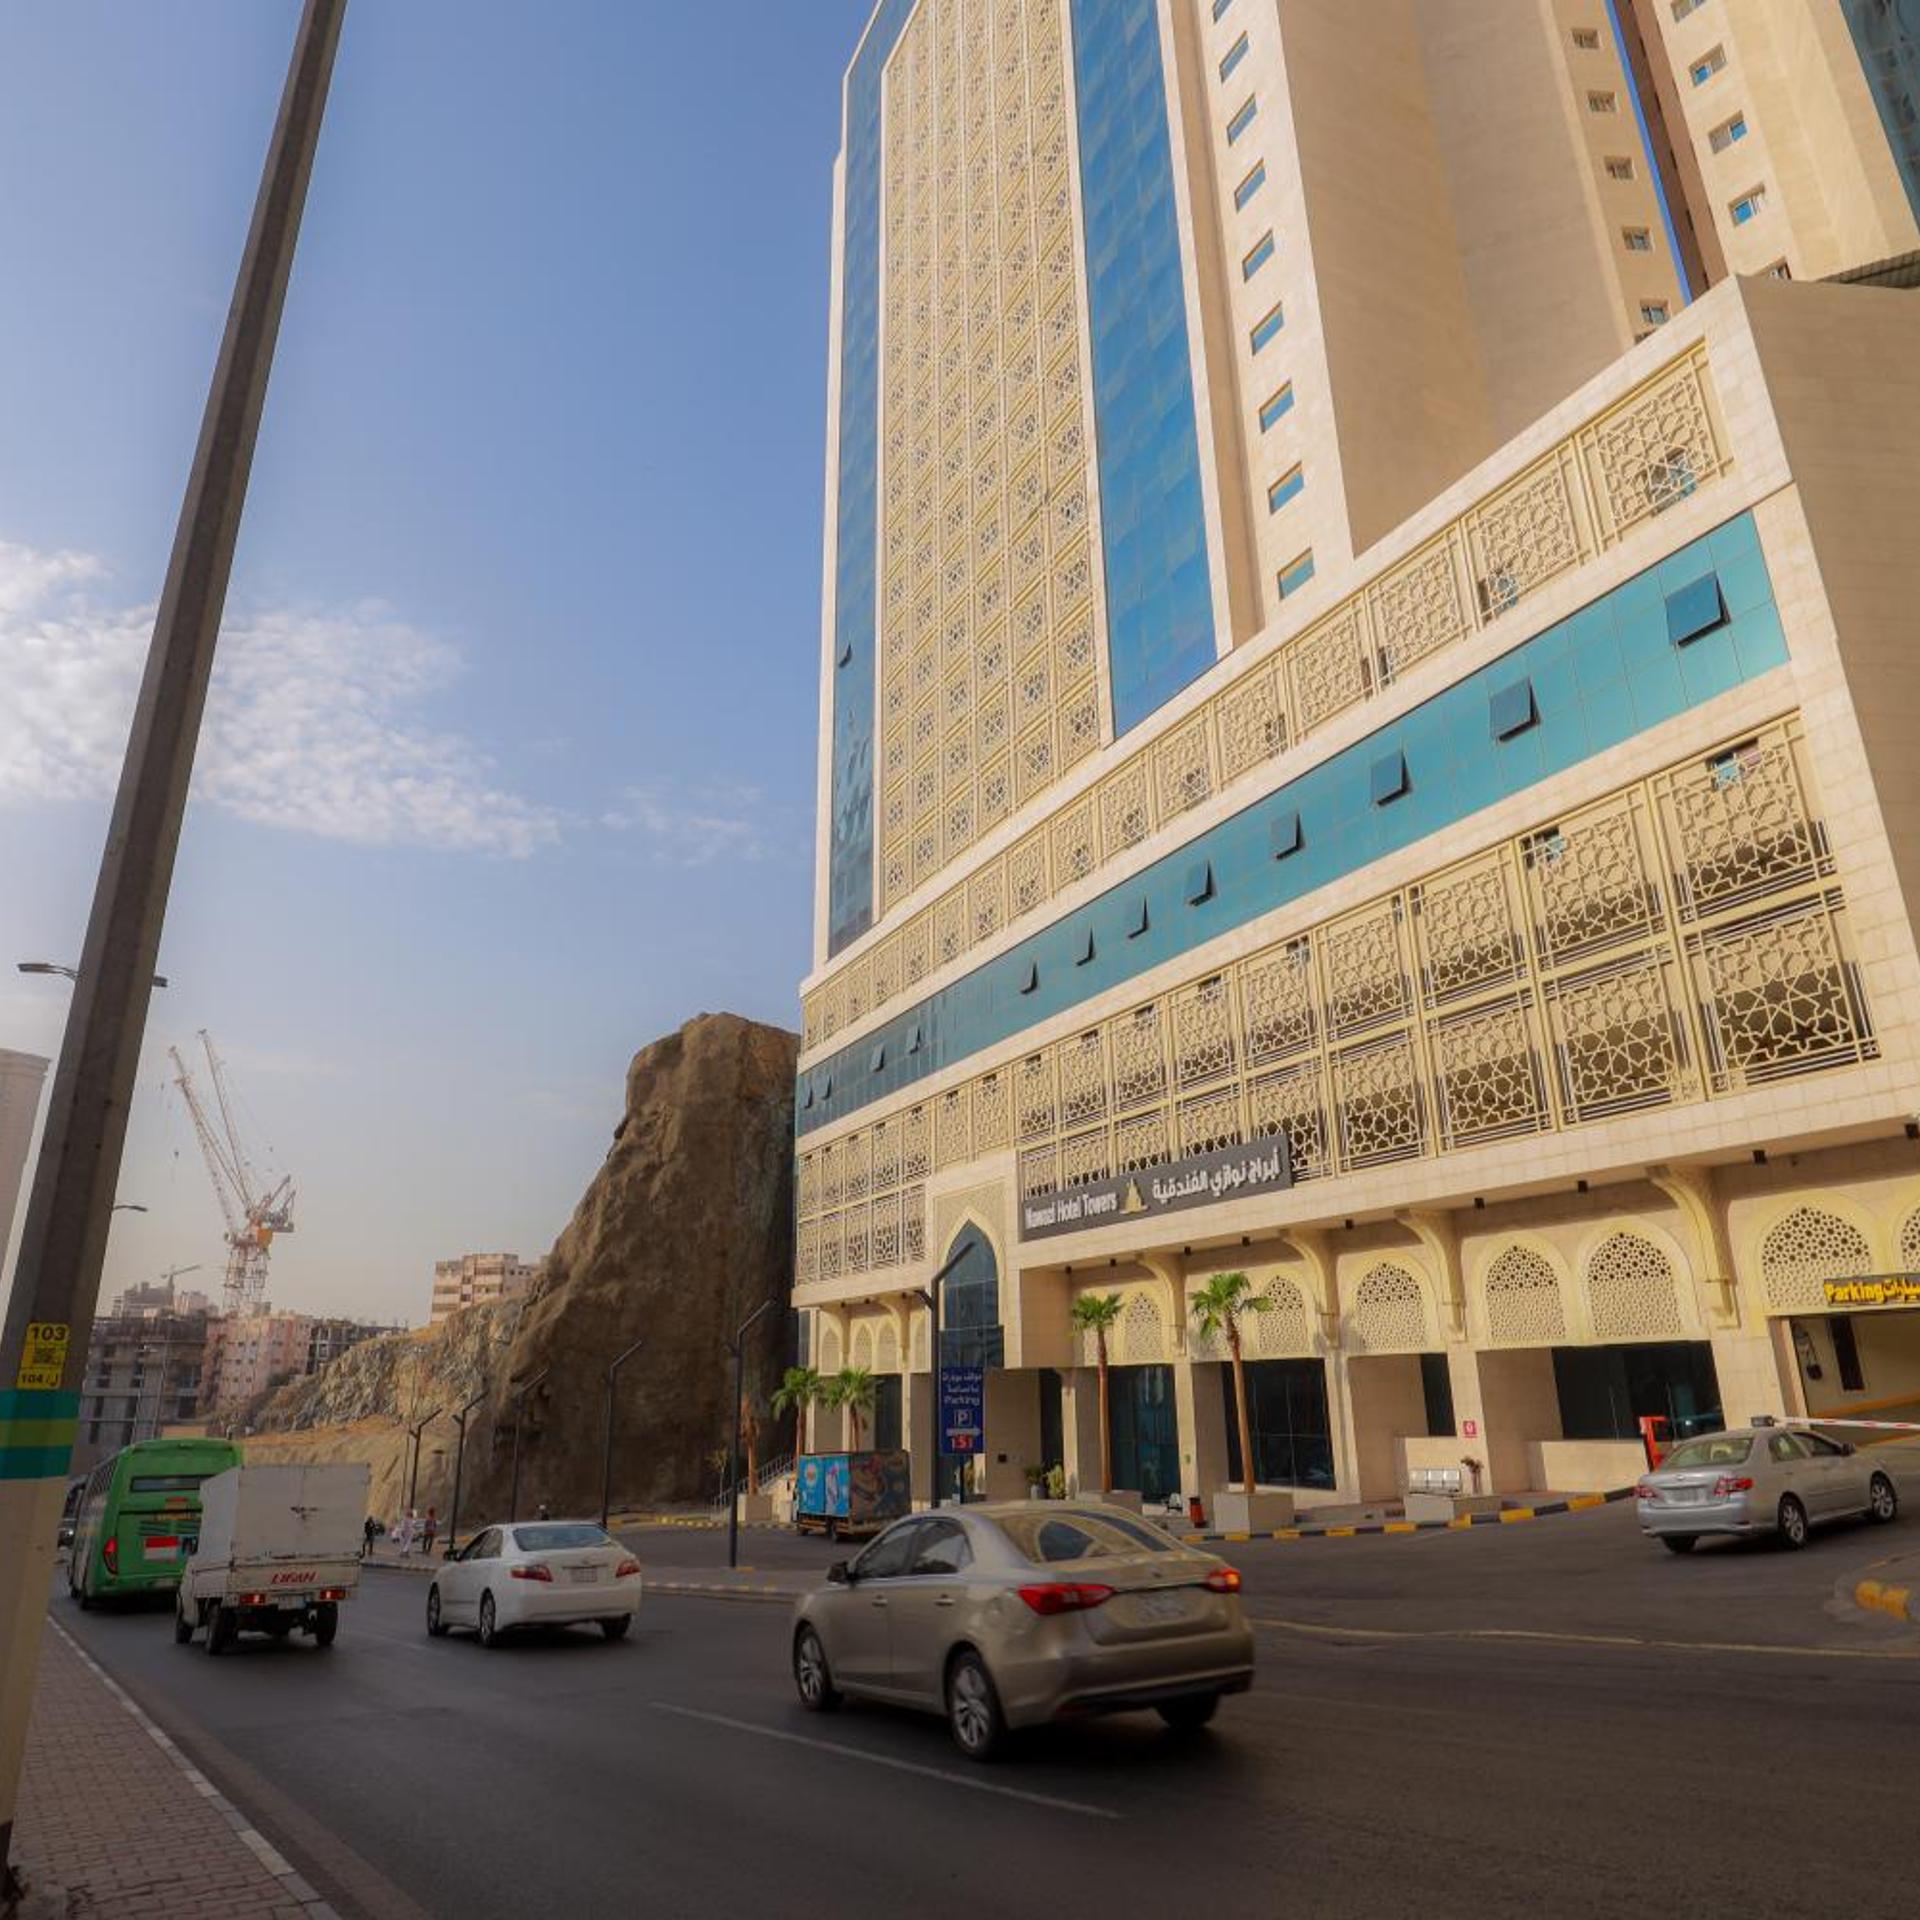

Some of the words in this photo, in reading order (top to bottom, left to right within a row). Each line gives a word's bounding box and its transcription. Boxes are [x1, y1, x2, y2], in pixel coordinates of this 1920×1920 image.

[1153, 1170, 1208, 1205] الفندقية
[1057, 1196, 1082, 1223] Hotel
[1082, 1192, 1118, 1217] Towers
[1823, 1281, 1885, 1304] Parking
[29, 1326, 66, 1341] 103
[944, 1395, 980, 1406] Parking
[957, 1412, 968, 1426] P
